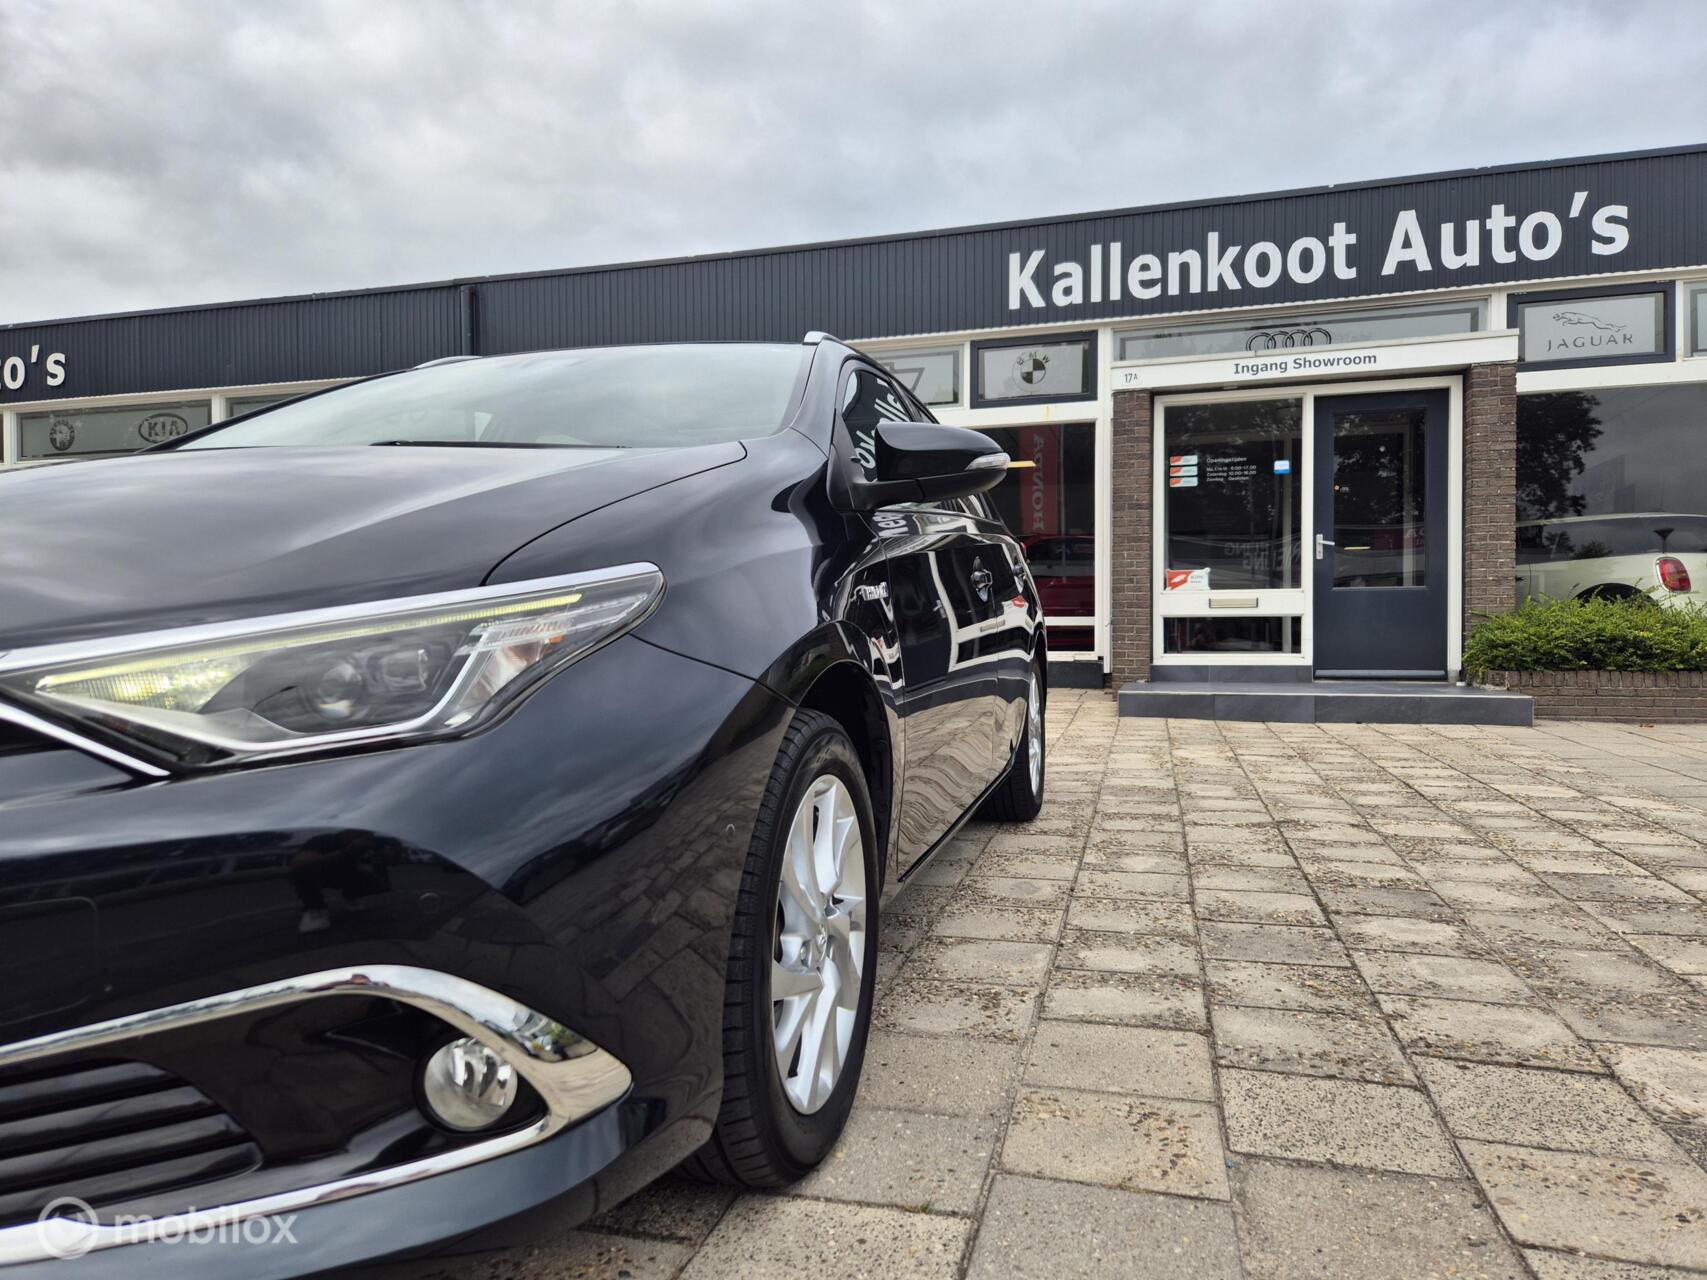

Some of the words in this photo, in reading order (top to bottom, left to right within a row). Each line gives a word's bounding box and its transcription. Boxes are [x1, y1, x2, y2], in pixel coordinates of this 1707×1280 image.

[1008, 222, 1357, 310] Kallenkoot
[1381, 192, 1629, 275] Auto's
[1547, 333, 1633, 352] JAGUAR
[0, 344, 66, 390] o's
[1234, 360, 1288, 375] Ingang
[1293, 353, 1377, 370] Showroom
[147, 419, 182, 437] KIA
